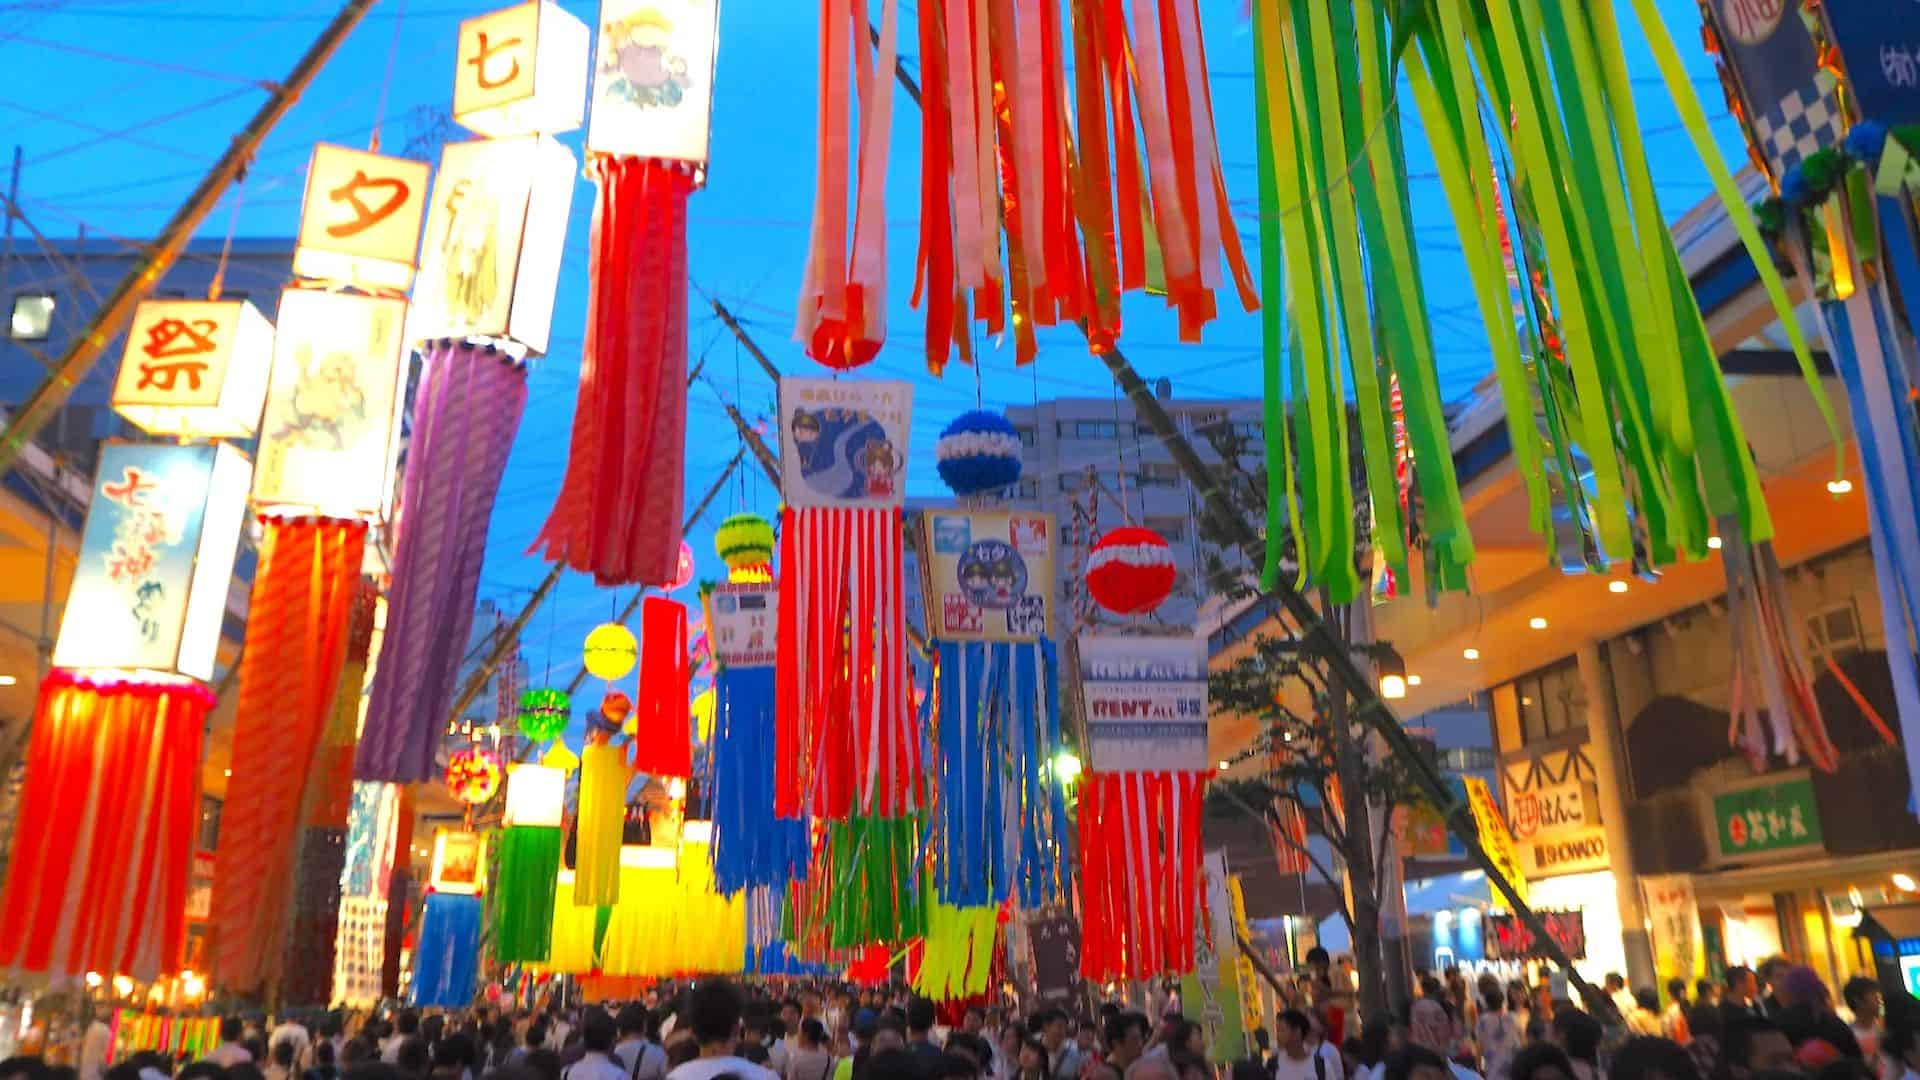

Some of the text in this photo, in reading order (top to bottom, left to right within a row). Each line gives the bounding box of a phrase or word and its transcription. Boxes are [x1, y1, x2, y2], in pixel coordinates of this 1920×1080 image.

[467, 31, 521, 90] 七
[326, 169, 410, 238] 夕
[137, 317, 218, 391] 祭
[1093, 698, 1152, 718] RENT
[1539, 793, 1582, 827] はんこ
